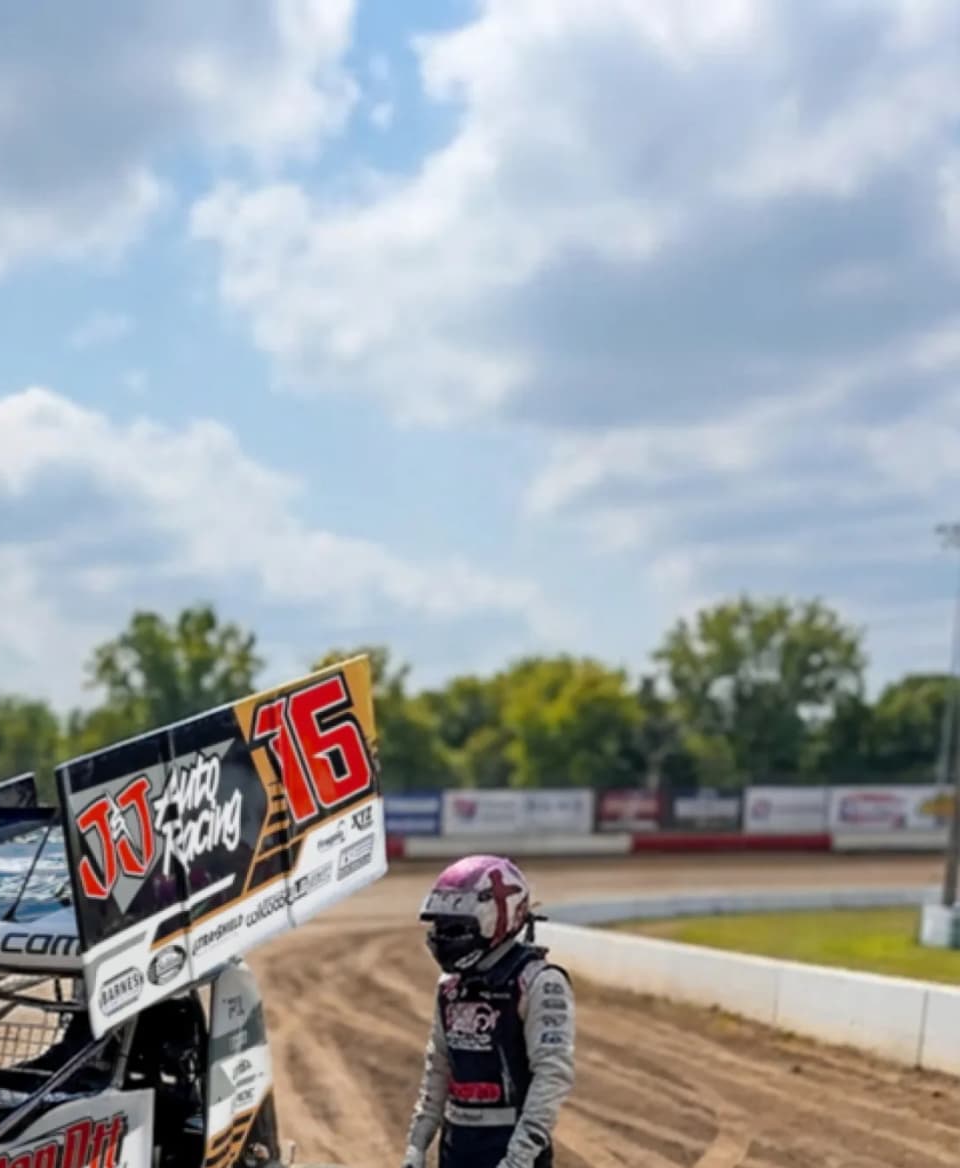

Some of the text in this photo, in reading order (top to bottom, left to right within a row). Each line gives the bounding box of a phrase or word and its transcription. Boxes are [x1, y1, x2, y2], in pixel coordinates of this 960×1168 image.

[153, 754, 220, 830] Auto
[252, 674, 373, 824] 16
[161, 788, 242, 882] Racing
